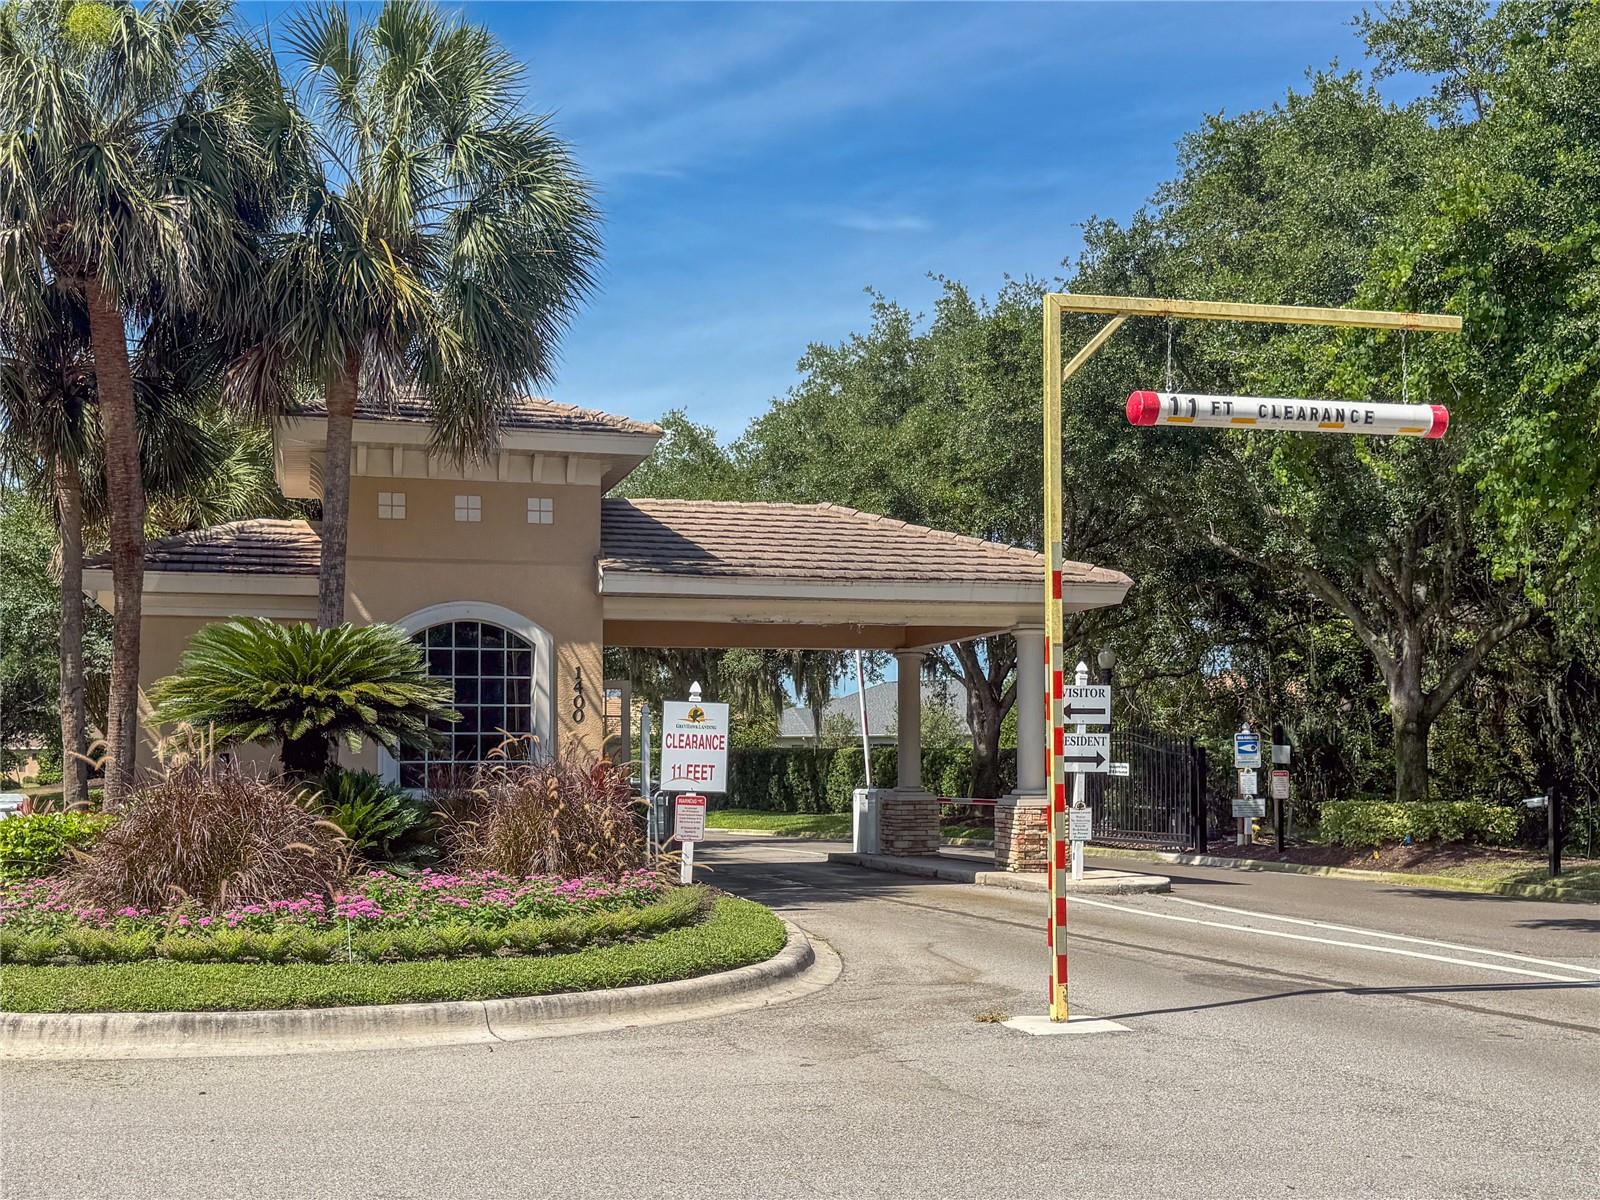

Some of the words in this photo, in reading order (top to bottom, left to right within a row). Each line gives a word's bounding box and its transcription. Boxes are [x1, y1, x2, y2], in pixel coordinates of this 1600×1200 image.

[1170, 396, 1197, 417] 11
[1212, 401, 1233, 416] FT
[1258, 404, 1375, 424] CLEARANCE
[572, 666, 585, 724] 1400
[666, 733, 725, 750] CLEARANCE
[1064, 736, 1107, 746] ESIDENT
[672, 764, 682, 779] 11
[687, 764, 715, 780] FEET
